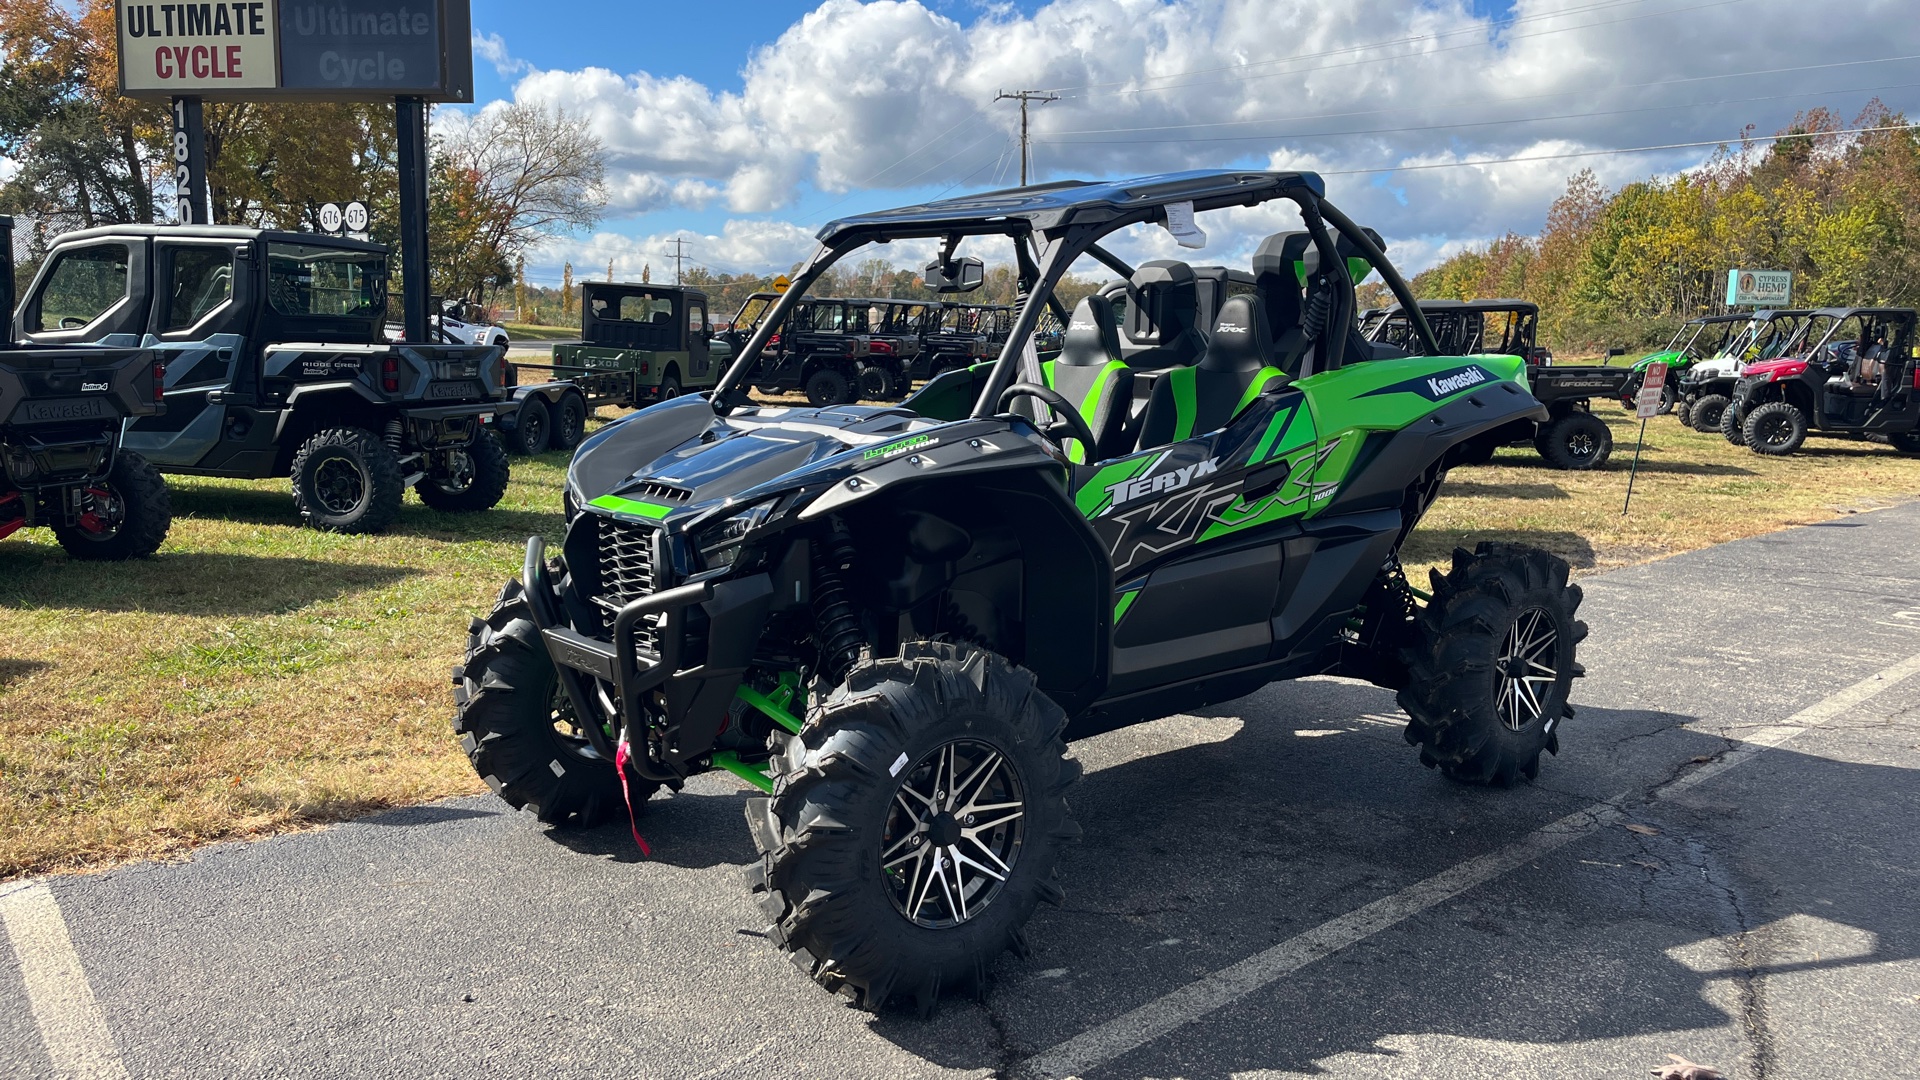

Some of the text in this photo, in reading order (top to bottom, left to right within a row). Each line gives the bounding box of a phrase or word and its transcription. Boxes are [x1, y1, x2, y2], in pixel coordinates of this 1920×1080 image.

[127, 2, 266, 38] ULTIMATE
[294, 5, 430, 36] Ultimate
[155, 45, 243, 79] CYCLE
[319, 50, 406, 88] Cycle
[174, 99, 193, 226] 1820
[323, 210, 339, 225] 676
[348, 209, 365, 224] 675
[1757, 282, 1787, 293] HEMP
[1758, 275, 1788, 283] CYPRESS
[1427, 365, 1486, 397] Kawasaki
[1651, 366, 1661, 376] NO
[431, 383, 474, 398] Kawasaki
[26, 399, 103, 421] Kawasaki
[863, 434, 929, 460] LIFTED
[883, 437, 940, 459] EDITION
[1104, 456, 1220, 506] TERYX
[1313, 486, 1339, 502] 1000
